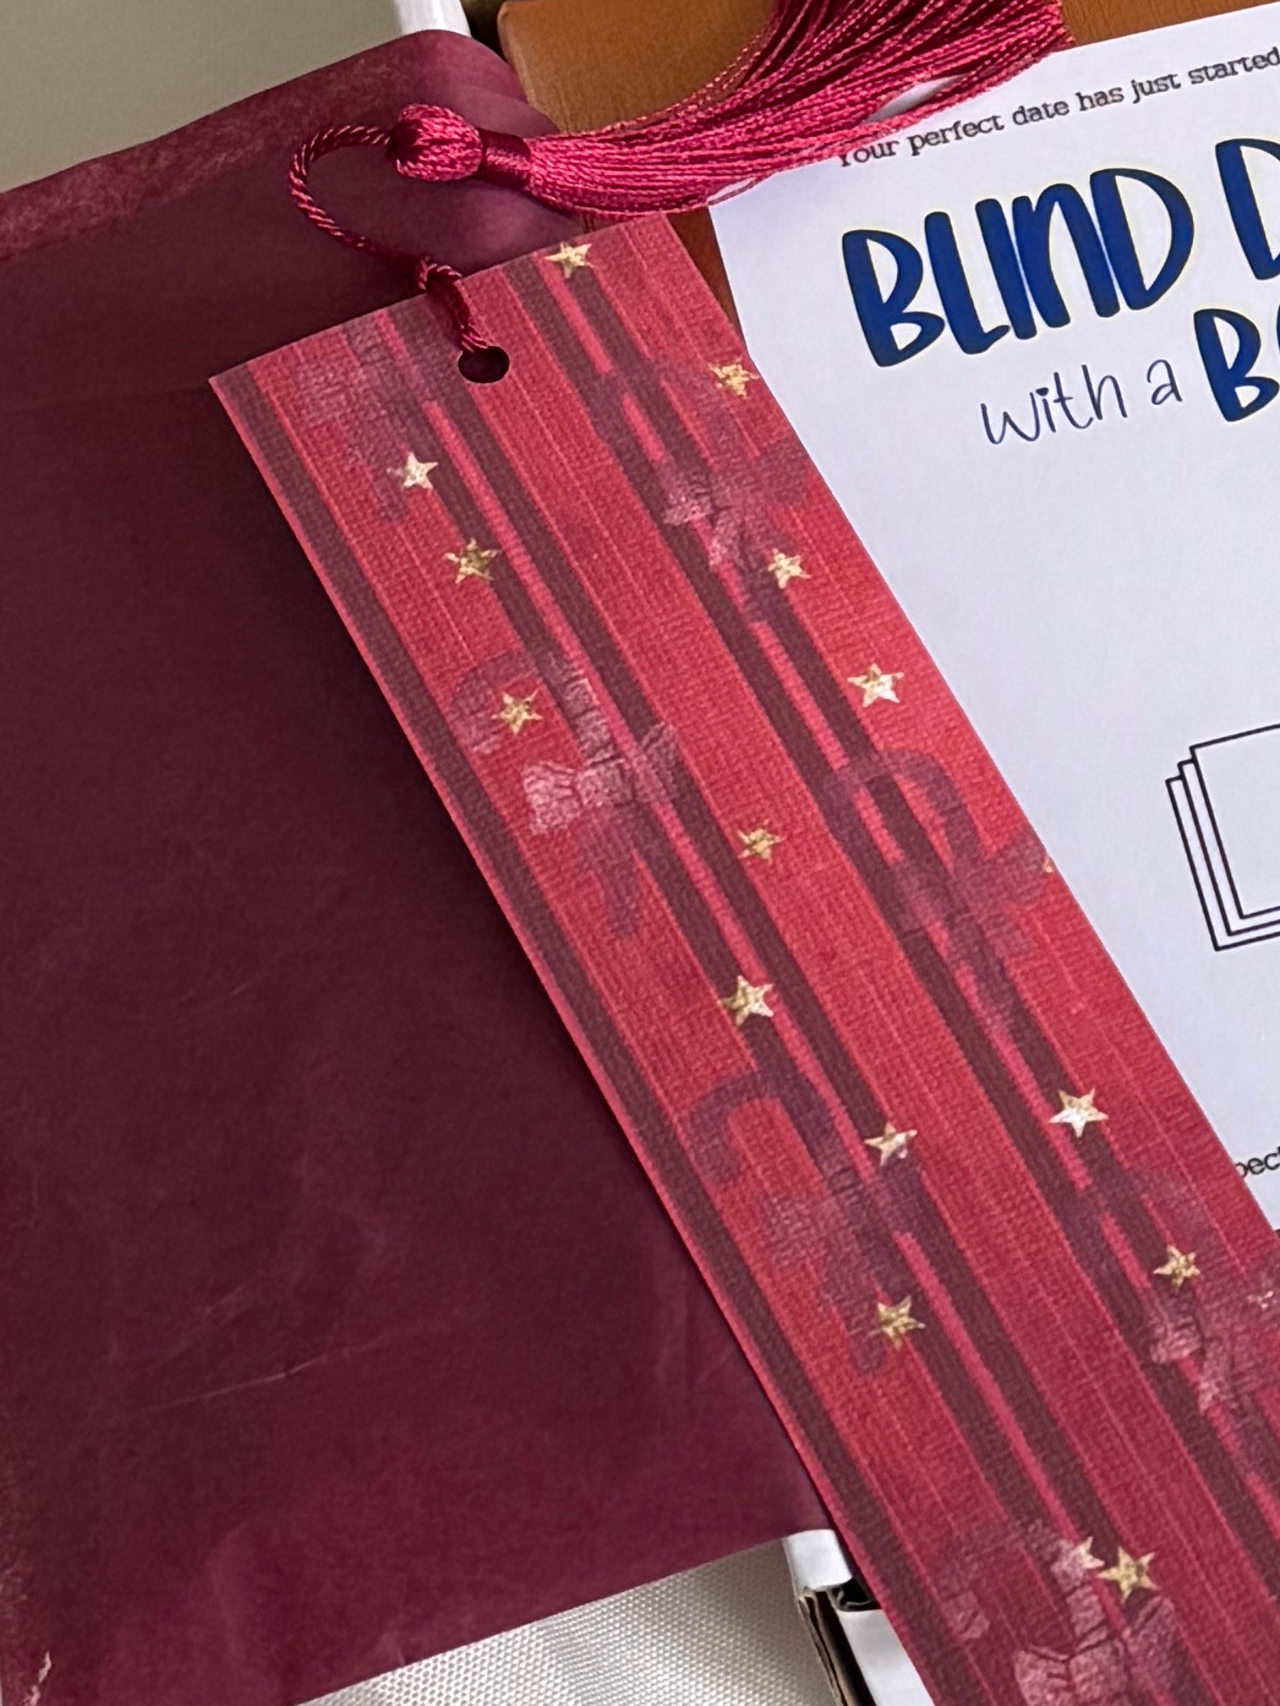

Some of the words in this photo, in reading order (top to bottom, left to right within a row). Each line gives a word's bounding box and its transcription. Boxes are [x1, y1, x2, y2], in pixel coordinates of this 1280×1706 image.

[840, 140, 900, 167] Your
[908, 115, 1005, 157] perfect
[1012, 101, 1070, 126] date
[1077, 85, 1124, 111] has
[1131, 74, 1181, 103] just
[841, 168, 1194, 367] BLIND
[981, 359, 1128, 446] with
[1146, 358, 1182, 406] a
